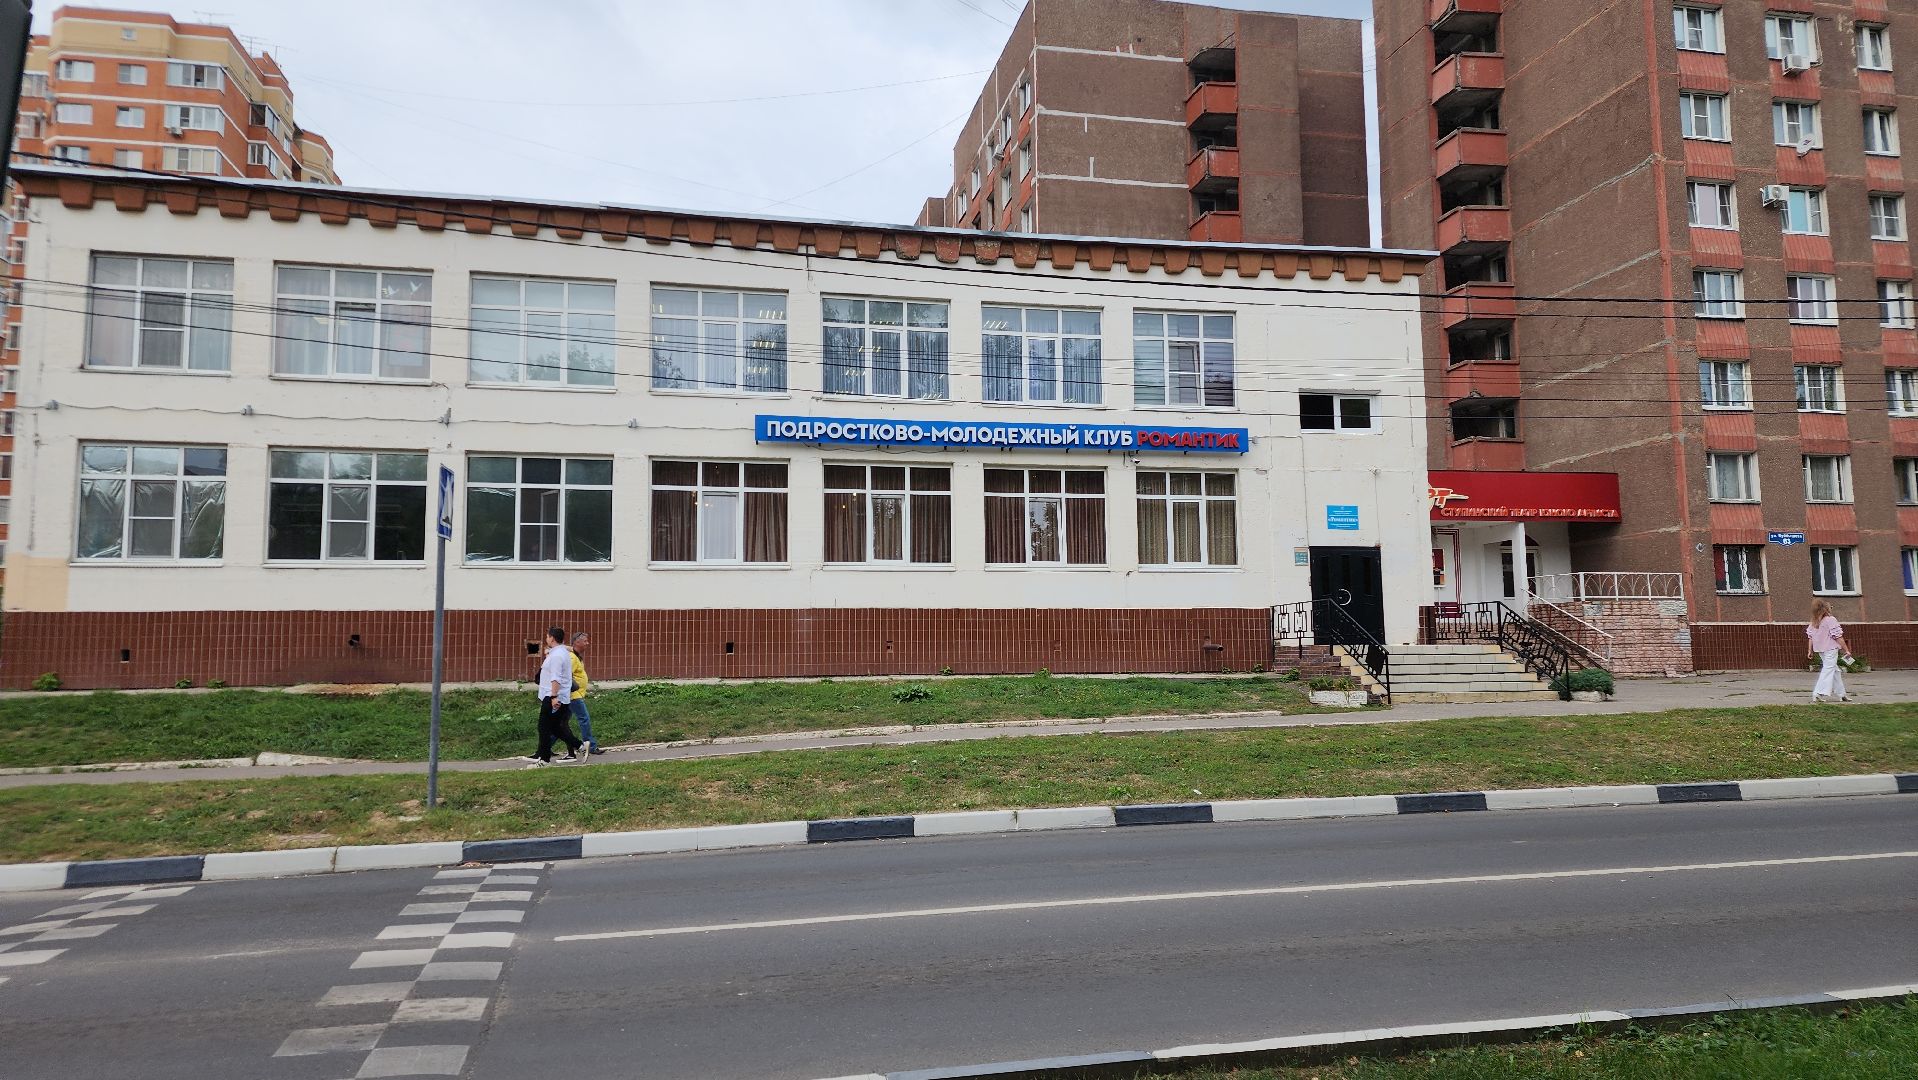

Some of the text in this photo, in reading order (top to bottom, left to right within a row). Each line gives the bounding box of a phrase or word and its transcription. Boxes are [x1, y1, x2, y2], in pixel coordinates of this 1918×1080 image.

[767, 420, 1240, 448] ПОДРОСТКОВО-МОЛОДЕЖНЫЙ КЛУБ РОМАНТИК
[1441, 506, 1509, 517] СТУПИНСКИЙ
[1510, 508, 1538, 517] ТЕАТР
[1577, 508, 1618, 518] АРТИСТА
